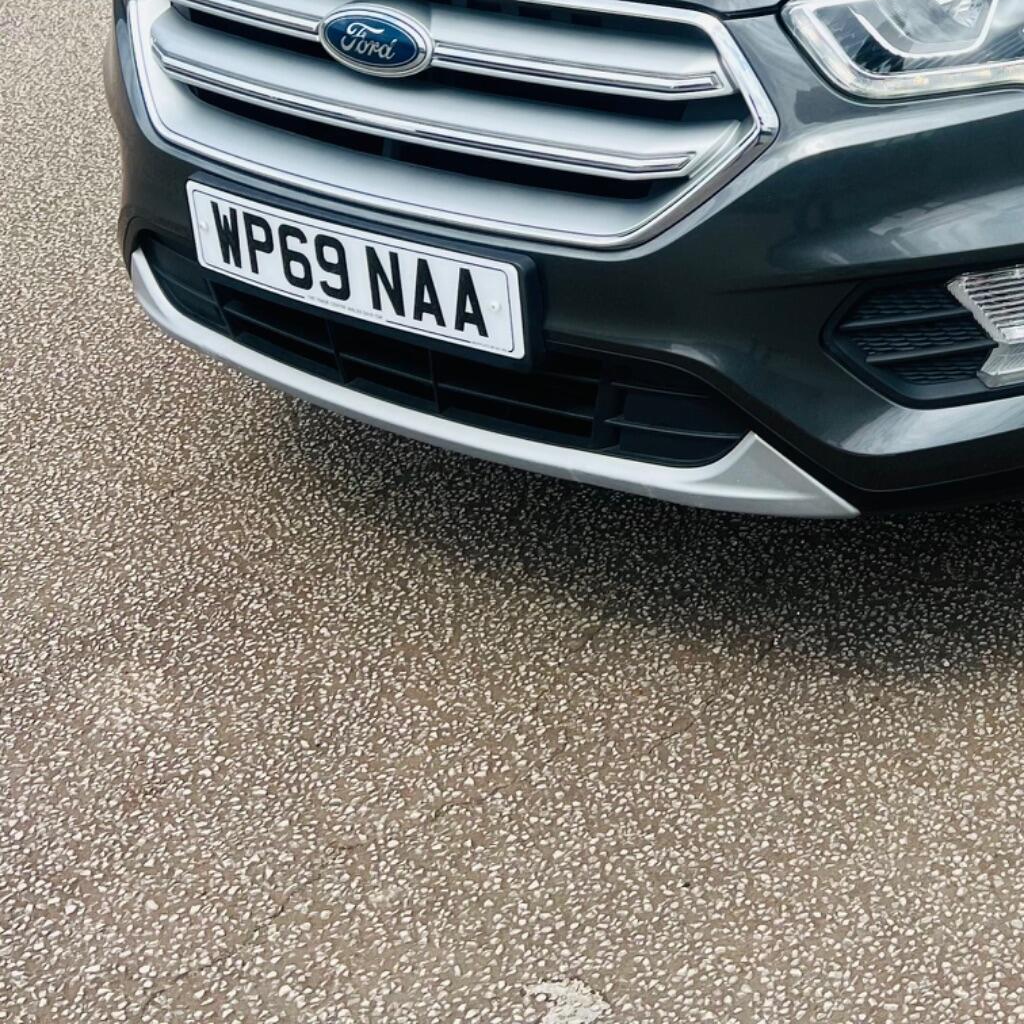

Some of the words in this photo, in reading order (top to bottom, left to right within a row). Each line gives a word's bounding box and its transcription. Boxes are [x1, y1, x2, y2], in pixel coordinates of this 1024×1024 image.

[341, 22, 398, 59] Ford
[210, 201, 351, 302] WP69
[365, 245, 489, 338] NAA
